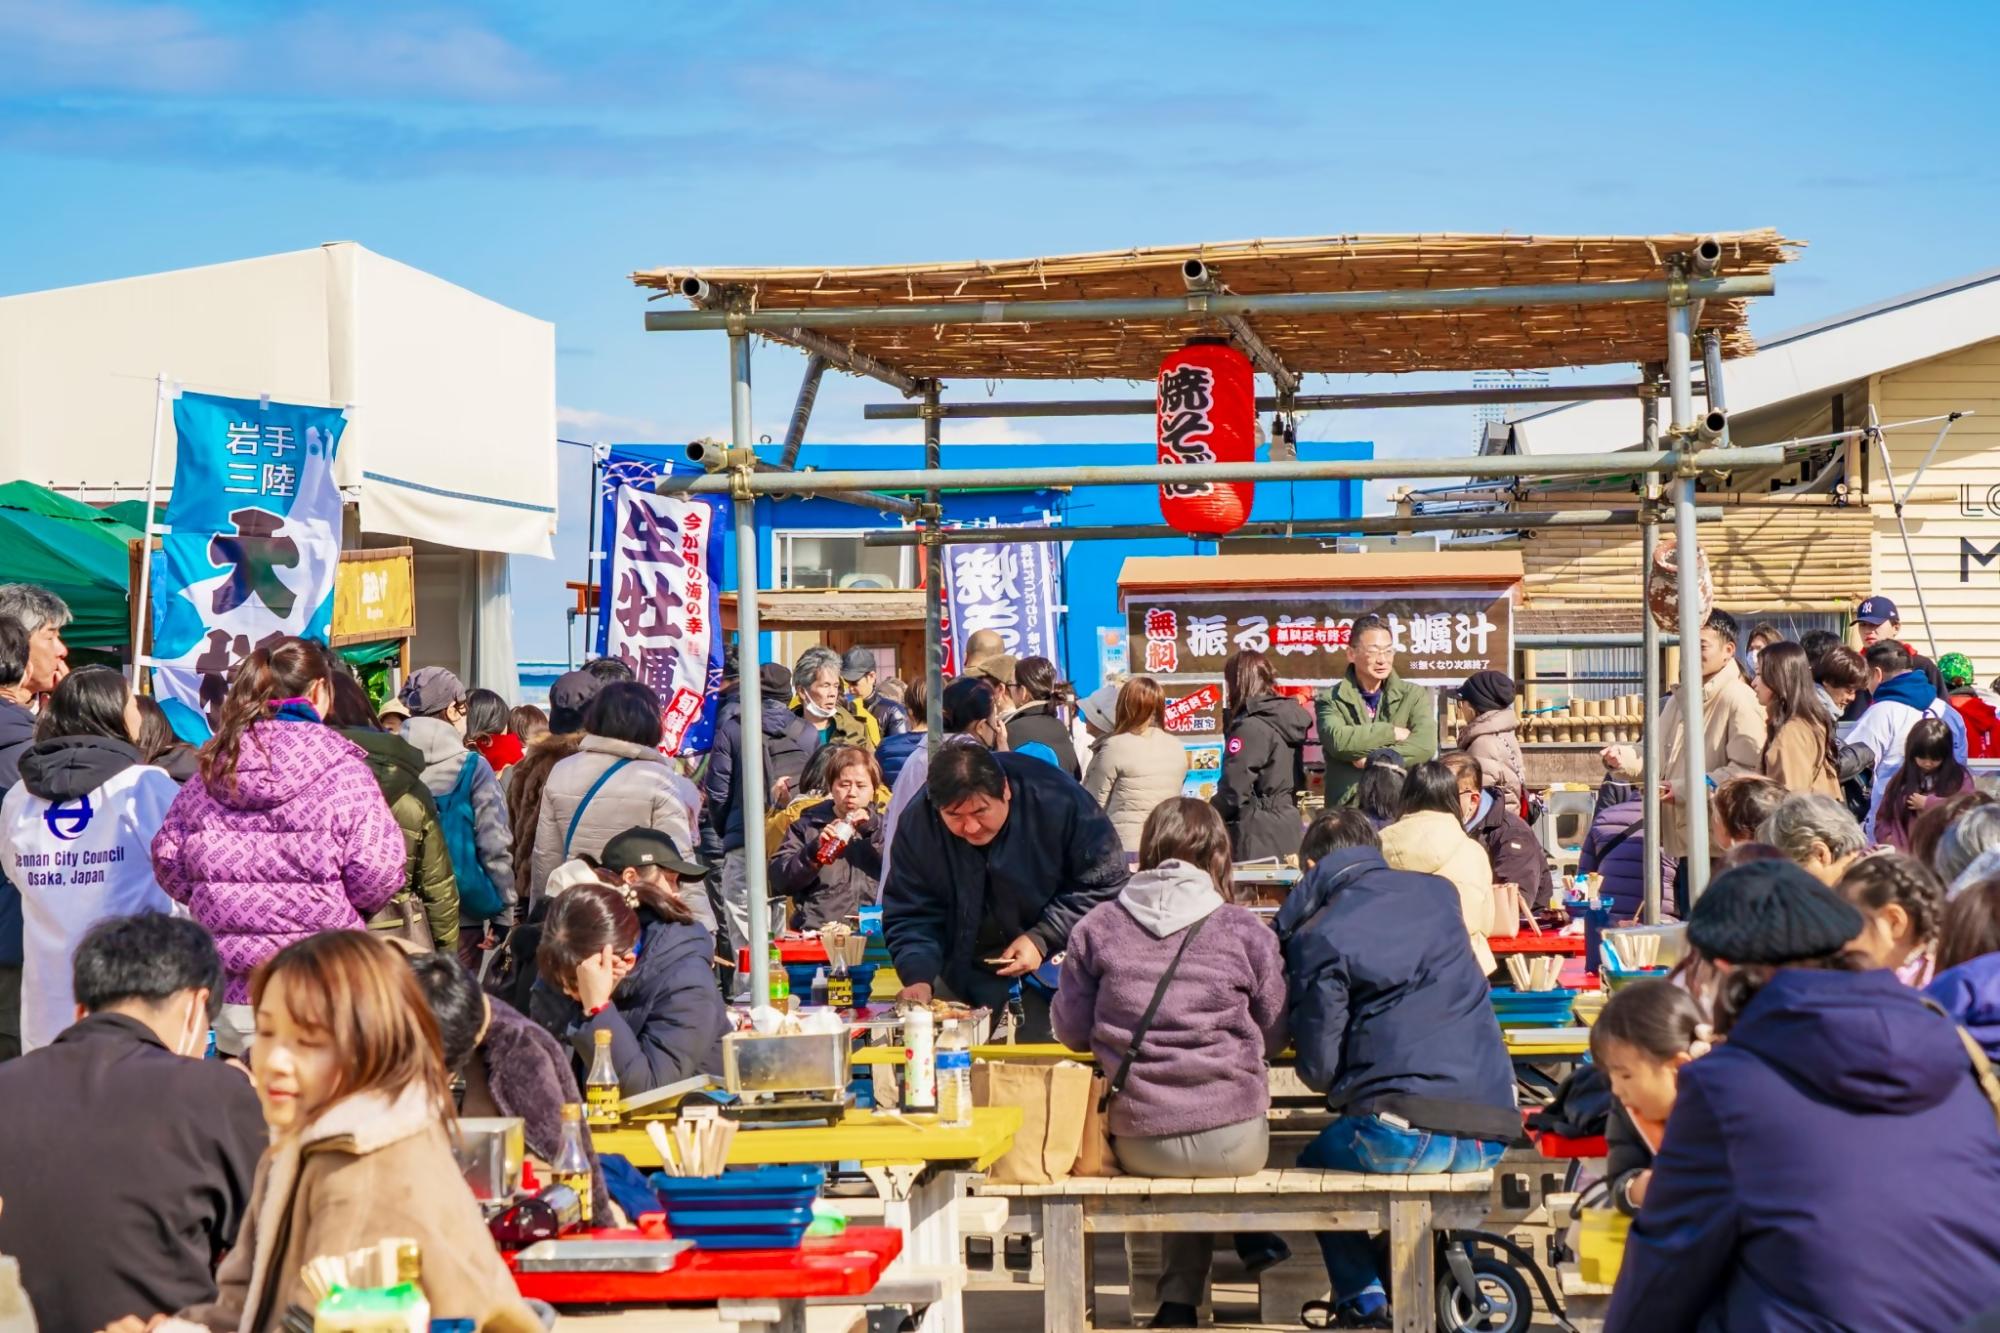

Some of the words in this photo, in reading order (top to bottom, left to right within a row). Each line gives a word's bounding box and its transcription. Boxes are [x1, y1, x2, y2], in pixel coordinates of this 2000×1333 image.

[226, 422, 296, 457] 岩手
[224, 463, 296, 497] 三陸
[1145, 608, 1179, 673] 無料
[55, 851, 78, 867] City
[83, 847, 124, 864] Council
[28, 871, 66, 886] Osaka,
[71, 869, 104, 886] Japan
